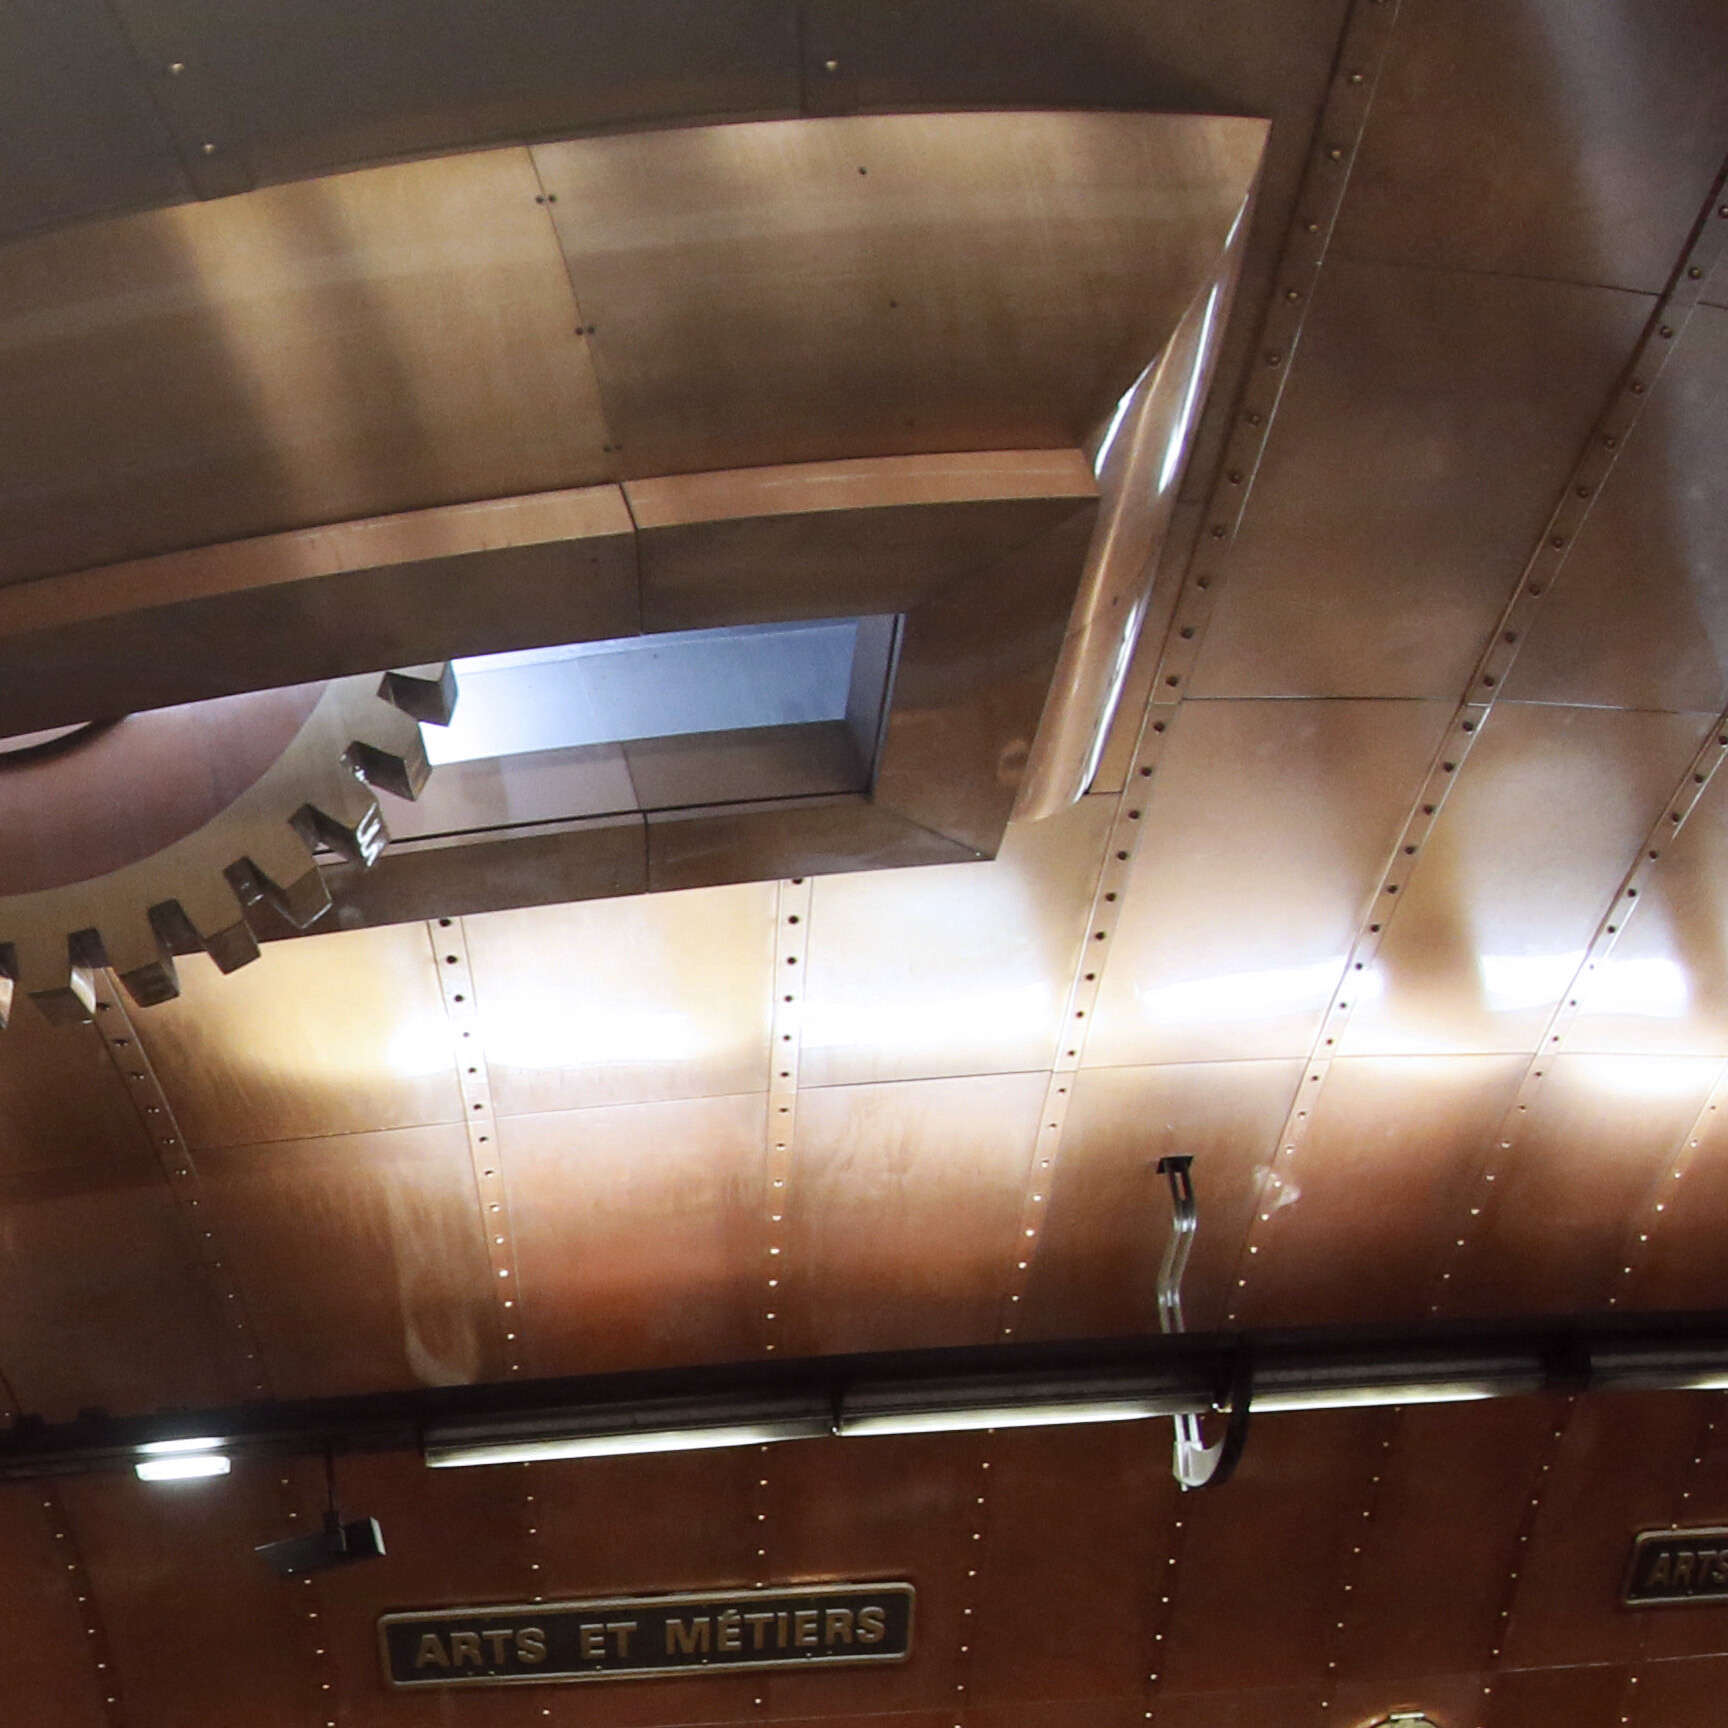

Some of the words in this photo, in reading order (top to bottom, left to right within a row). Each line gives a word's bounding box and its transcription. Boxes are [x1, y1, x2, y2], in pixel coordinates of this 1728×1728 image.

[415, 1627, 545, 1668] ARTS
[579, 1621, 638, 1659] ET
[665, 1608, 886, 1656] MÉTIERS
